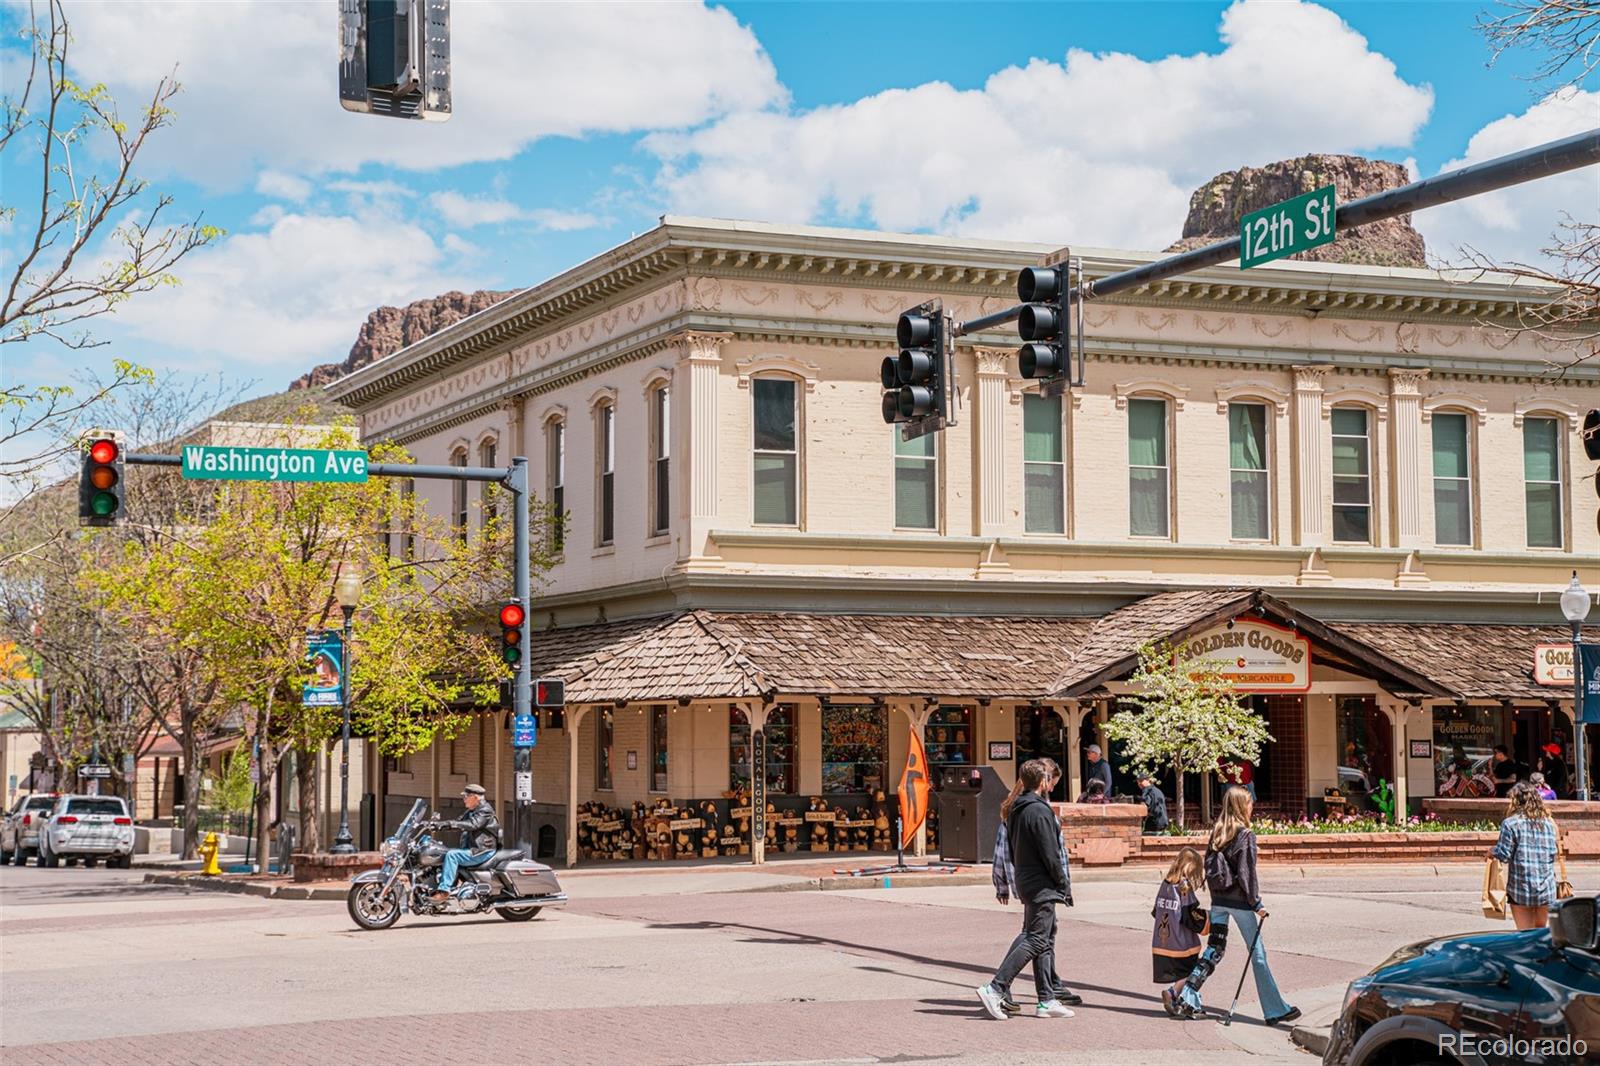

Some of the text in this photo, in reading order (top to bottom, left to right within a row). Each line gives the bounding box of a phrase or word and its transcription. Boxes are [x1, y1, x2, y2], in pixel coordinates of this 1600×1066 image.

[1244, 195, 1331, 261] 12th St
[186, 447, 365, 479] Washington Ave
[1247, 630, 1305, 664] GOODS
[755, 740, 763, 782] LOCAL
